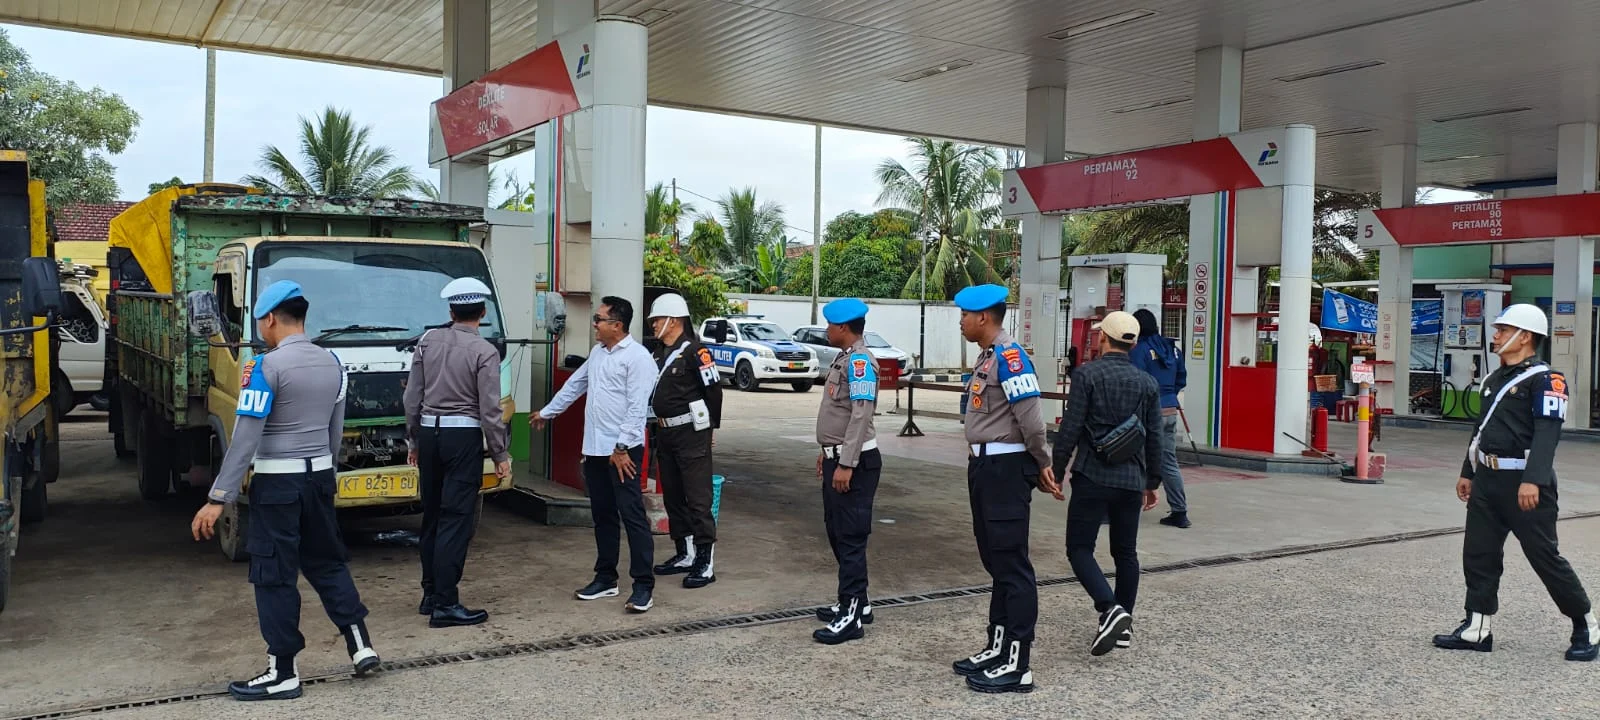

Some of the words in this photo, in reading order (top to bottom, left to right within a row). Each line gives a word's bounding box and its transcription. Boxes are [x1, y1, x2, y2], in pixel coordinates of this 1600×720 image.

[478, 116, 498, 135] SOLAR
[1084, 158, 1137, 176] PERTAMAX
[1125, 169, 1138, 181] 92
[1008, 187, 1018, 204] 3
[1453, 201, 1502, 213] PERTALITE
[1489, 211, 1502, 219] 90
[1452, 219, 1502, 230] PERTAMAX
[1364, 225, 1374, 239] 5
[1490, 228, 1503, 237] 92
[344, 477, 360, 492] KT
[366, 476, 395, 490] 8251
